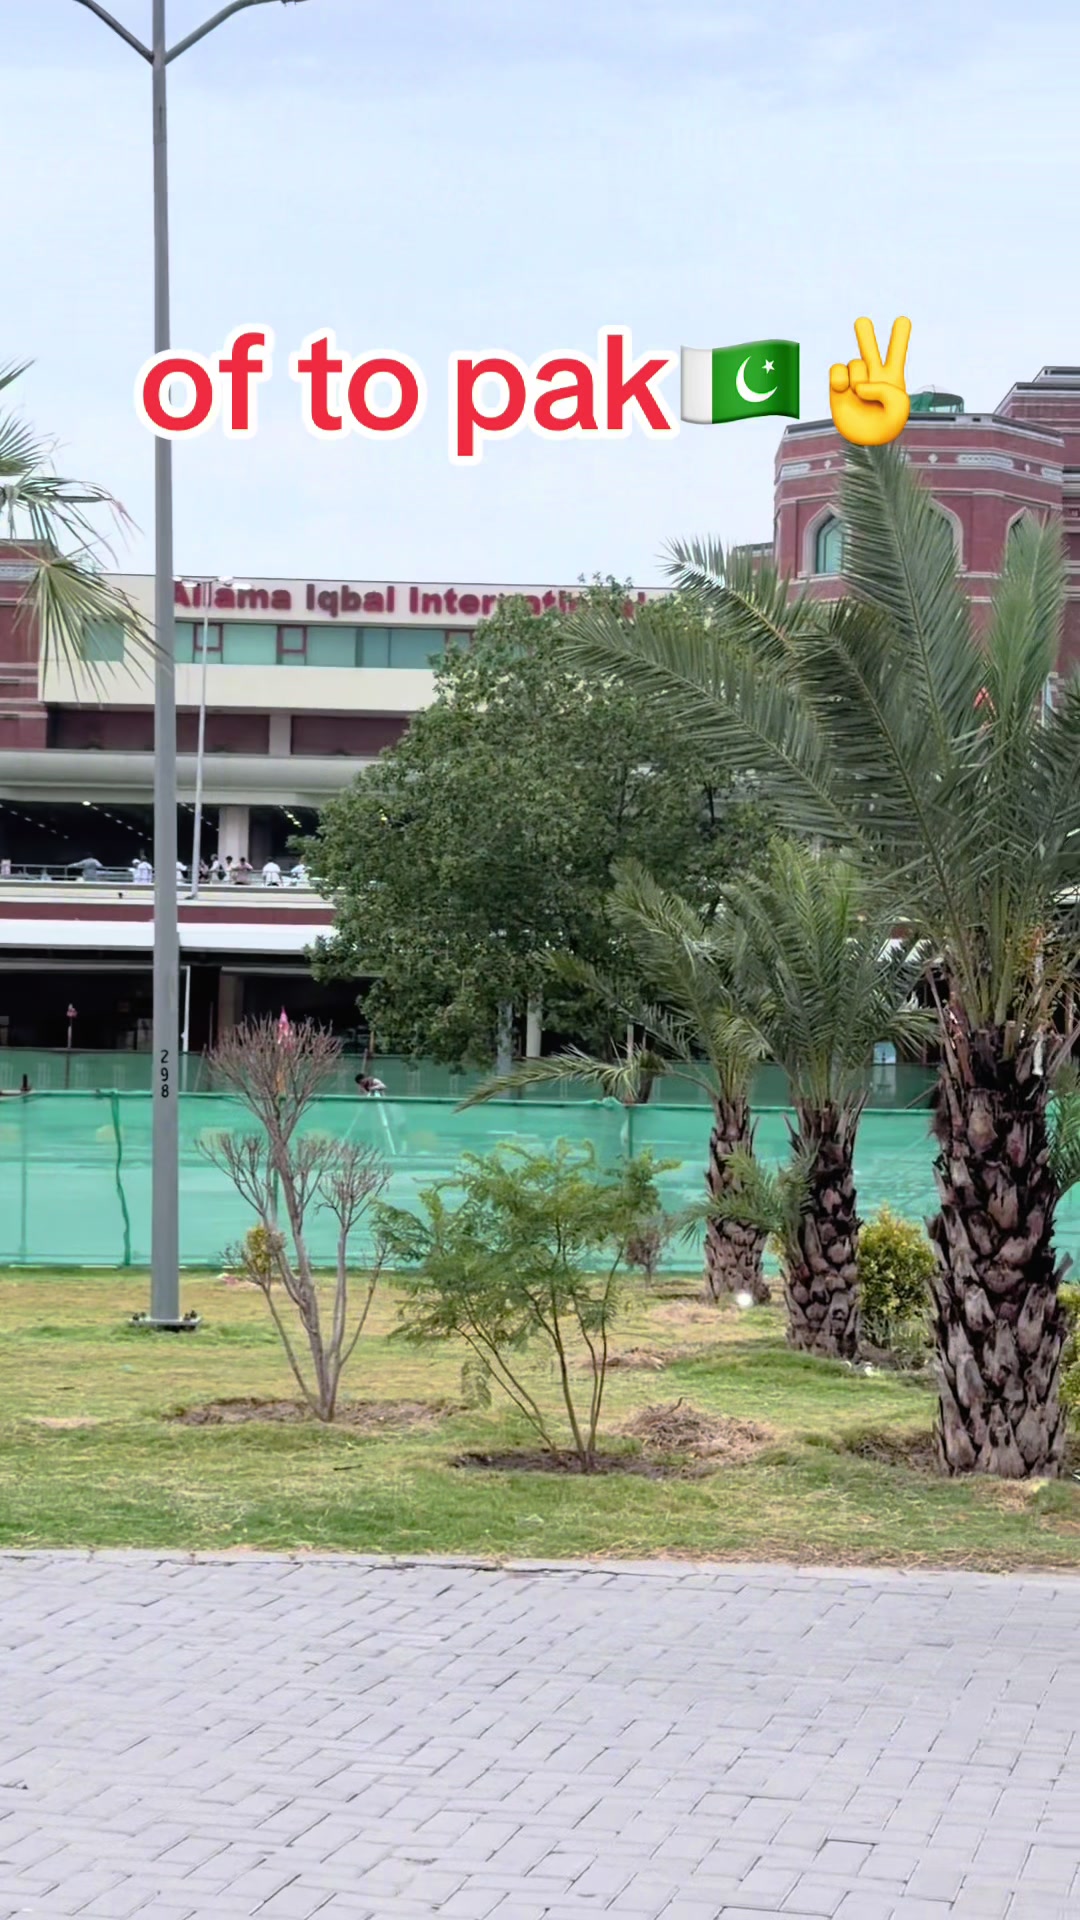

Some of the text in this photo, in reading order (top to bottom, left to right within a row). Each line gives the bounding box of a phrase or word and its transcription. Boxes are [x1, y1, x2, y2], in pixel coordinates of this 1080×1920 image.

[306, 583, 395, 618] Iqbal
[409, 586, 646, 618] Interati
[160, 1049, 170, 1098] 298
